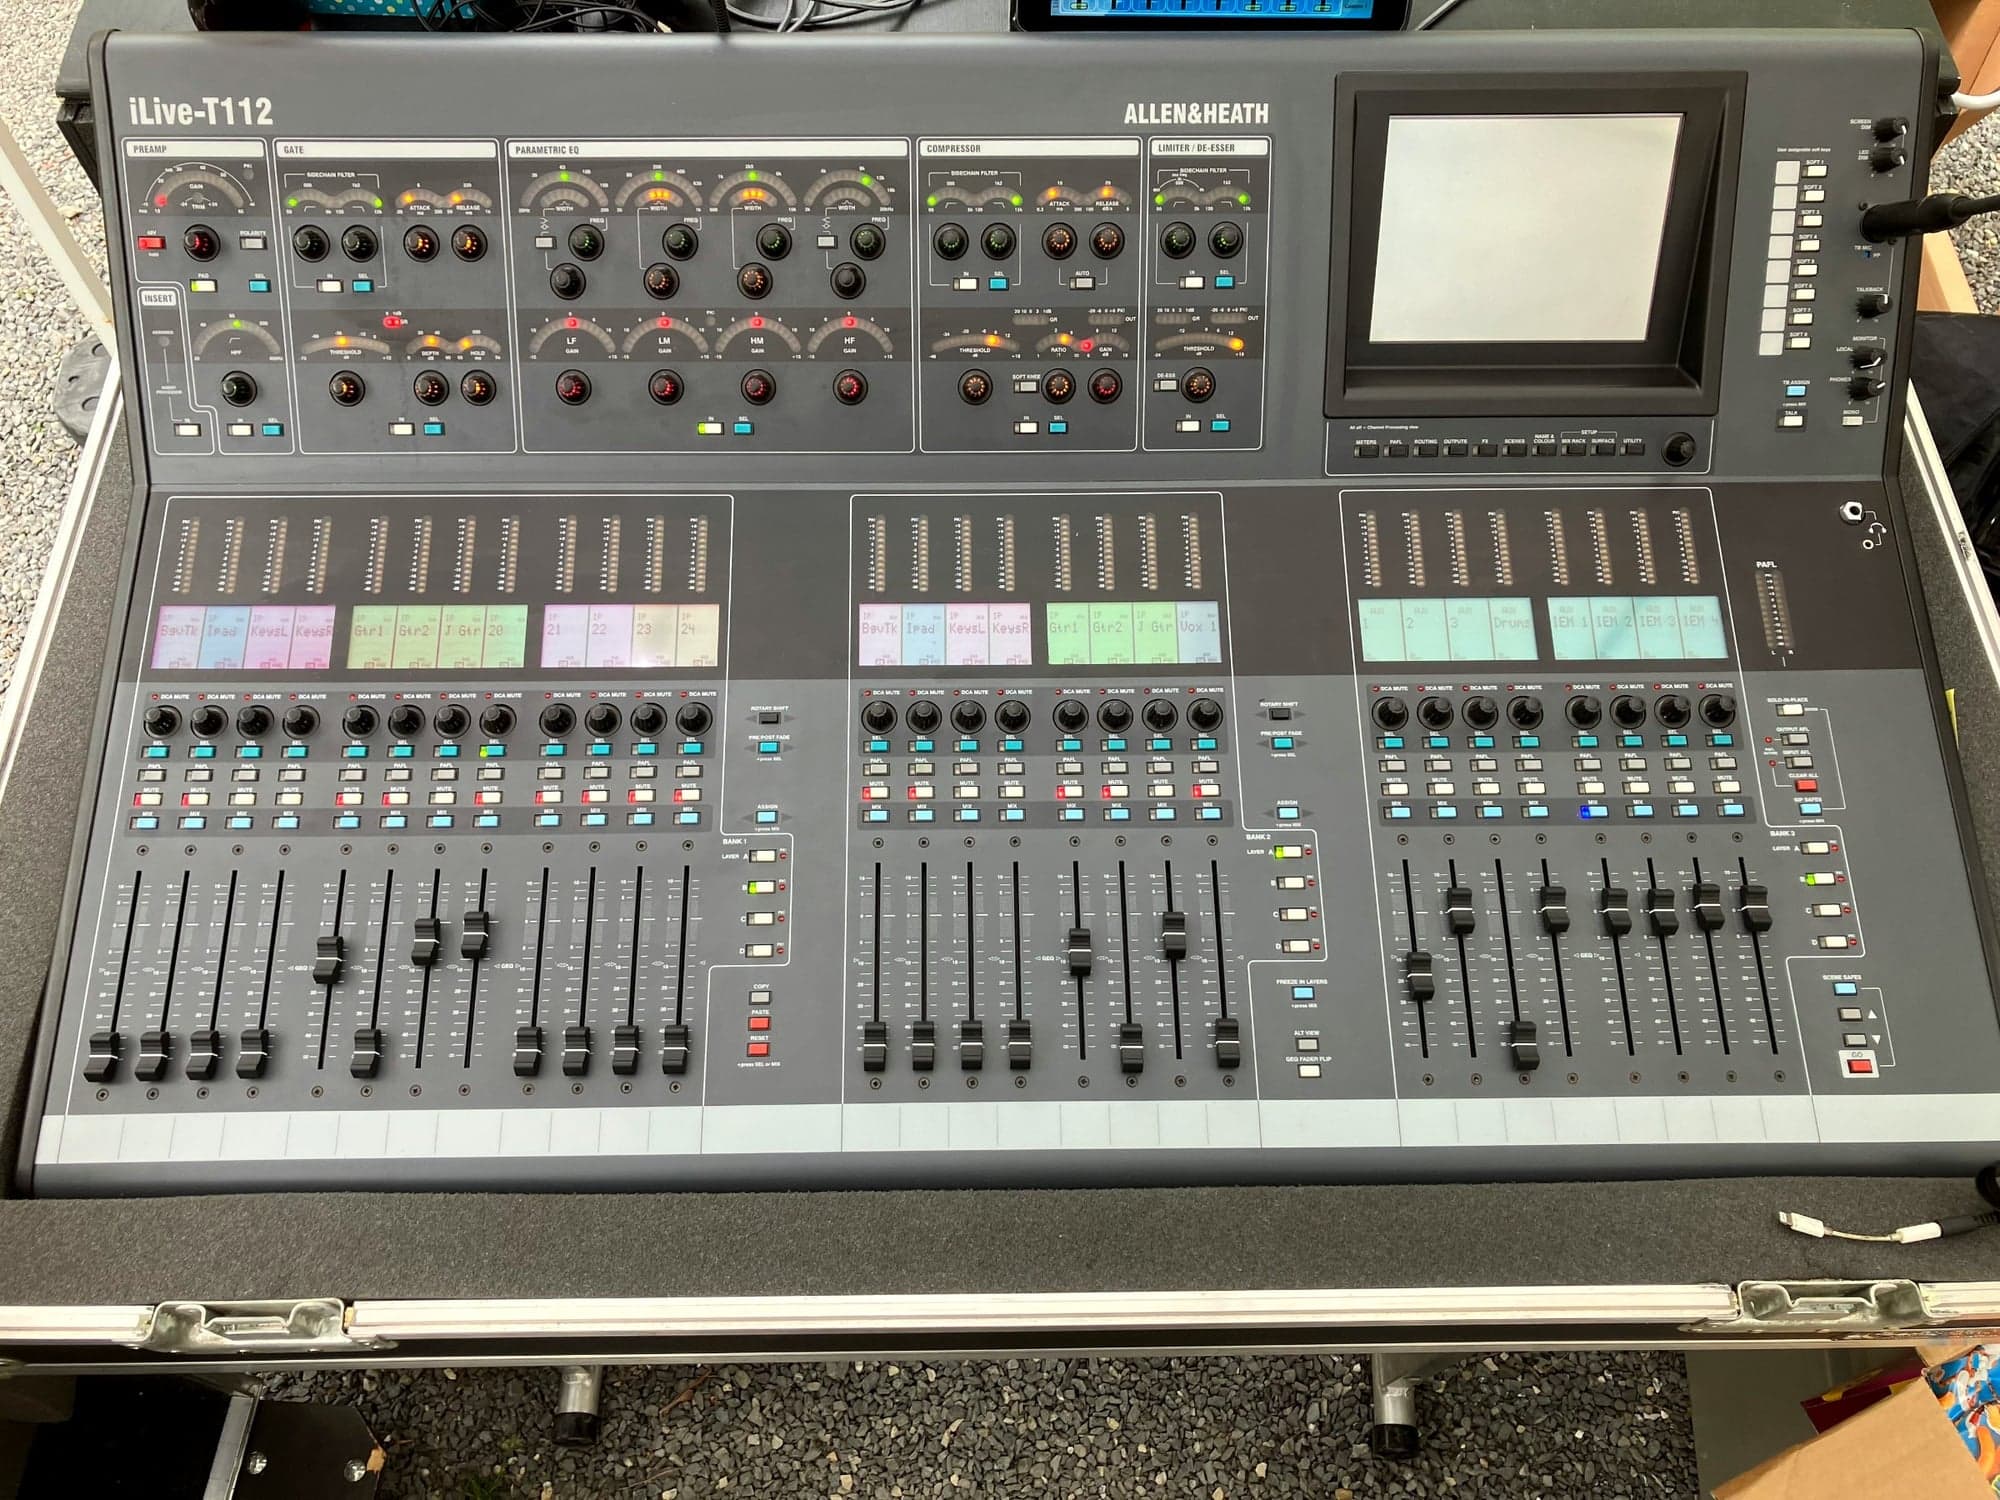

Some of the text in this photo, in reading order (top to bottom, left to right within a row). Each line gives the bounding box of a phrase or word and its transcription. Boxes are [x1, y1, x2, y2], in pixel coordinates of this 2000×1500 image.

[129, 97, 273, 125] iLive-T112
[1124, 103, 1269, 124] ALLEN&HEATH
[133, 145, 167, 153] PREAMP
[283, 145, 304, 154] GATE
[515, 146, 580, 155] PARAMETRIC EQ
[927, 145, 981, 153] COMPRESSOR
[1158, 144, 1190, 152] LIMITER
[1197, 144, 1235, 152] DE-ESSER
[144, 295, 173, 303] INSERT
[567, 337, 576, 345] LF
[659, 337, 671, 345] LM
[1093, 622, 1122, 632] Gtr2
[1151, 622, 1173, 632] Gtr
[1180, 622, 1216, 632] Vox 1
[1407, 618, 1414, 628] 2
[1451, 618, 1458, 628] 3
[1553, 616, 1587, 627] IEM 1
[1596, 616, 1633, 627] IEM 2
[1640, 616, 1675, 627] IEM 3
[1683, 616, 1718, 627] IEM 4
[207, 625, 237, 637] Ipad
[251, 626, 288, 637] KeysL
[295, 626, 332, 637] KeysR
[354, 625, 383, 637] Gtr1
[399, 625, 430, 637] Gtr2
[459, 625, 481, 636] Gtr
[488, 625, 503, 636] 20
[547, 624, 561, 635] 21
[592, 624, 607, 635] 22
[637, 624, 651, 635] 23
[681, 624, 695, 635] 24
[907, 623, 935, 634] Ipad
[950, 623, 986, 634] KeysL
[993, 623, 1029, 634] KeysR
[1050, 622, 1078, 633] Gtr1
